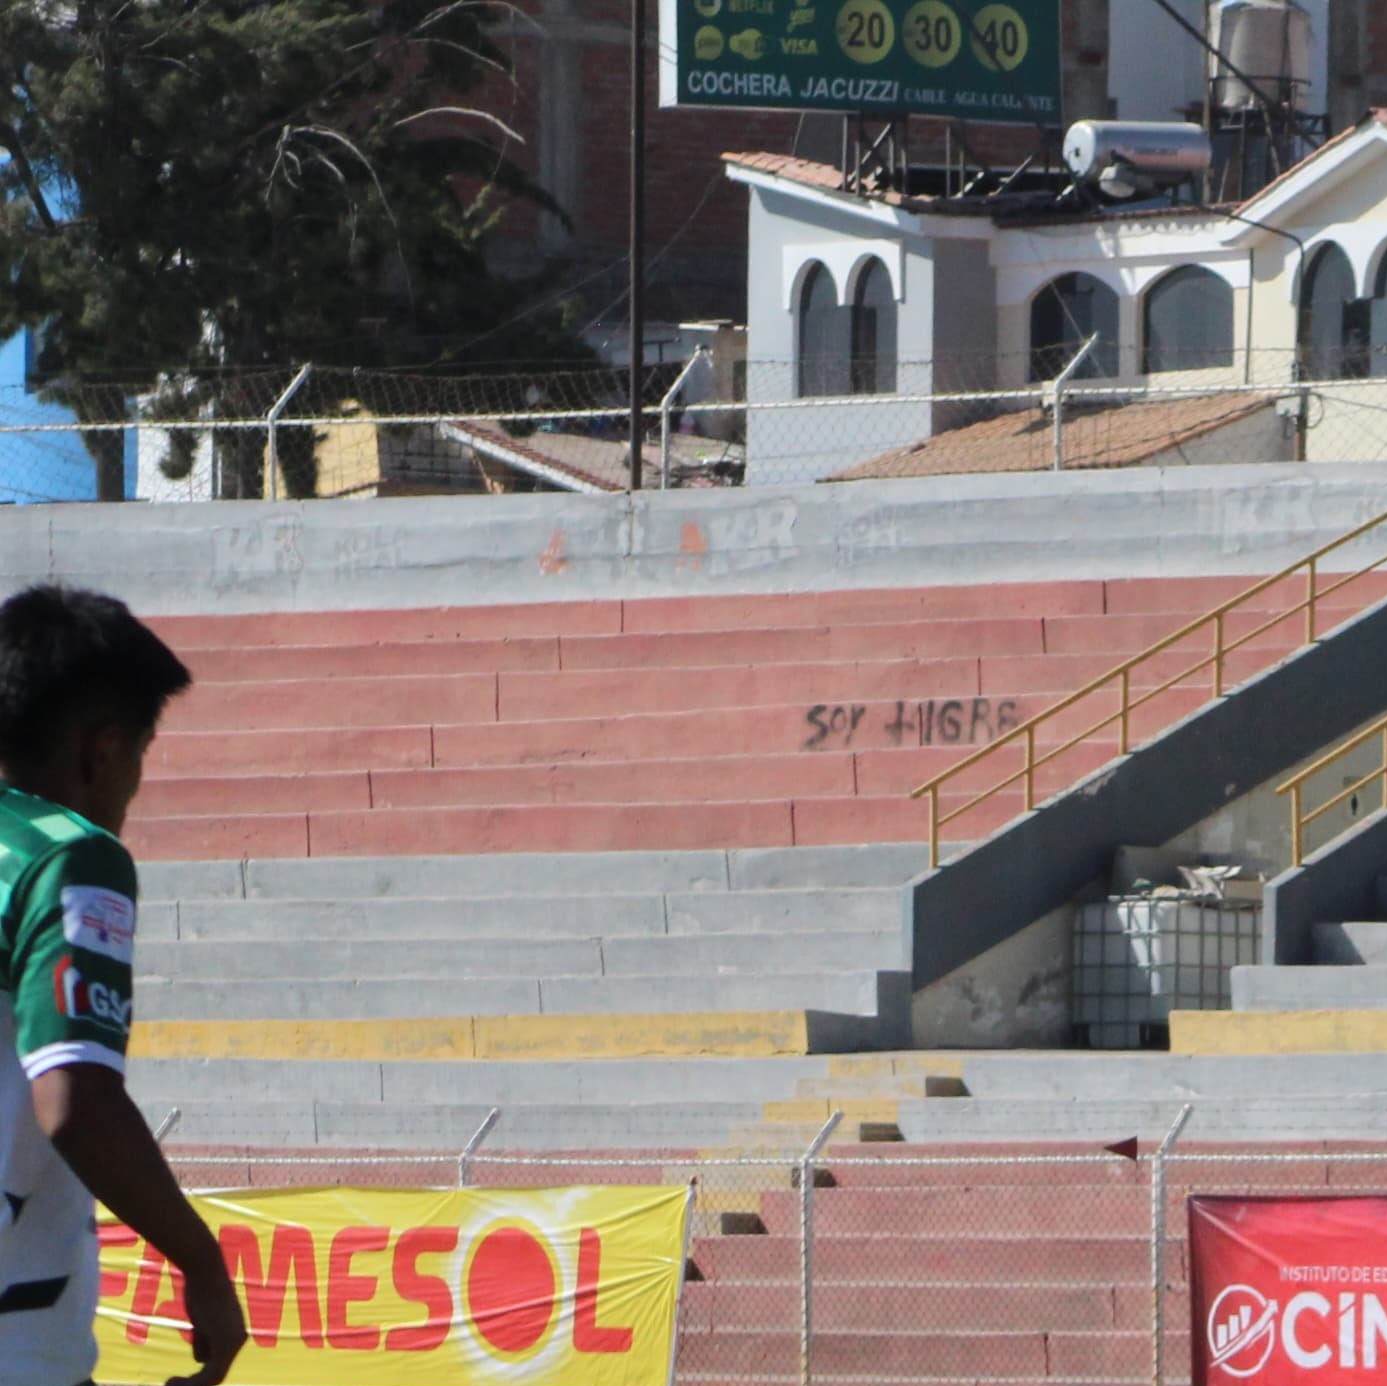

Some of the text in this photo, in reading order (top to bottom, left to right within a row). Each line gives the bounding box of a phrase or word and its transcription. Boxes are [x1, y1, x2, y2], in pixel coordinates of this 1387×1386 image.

[780, 37, 819, 56] VISA
[847, 12, 885, 48] 20
[915, 15, 952, 53] 30
[983, 19, 1019, 58] 40
[687, 70, 793, 98] COCHERA
[800, 76, 899, 102] JACUZZI
[1280, 1265, 1349, 1283] INSTITUTO
[1351, 1266, 1371, 1283] DE
